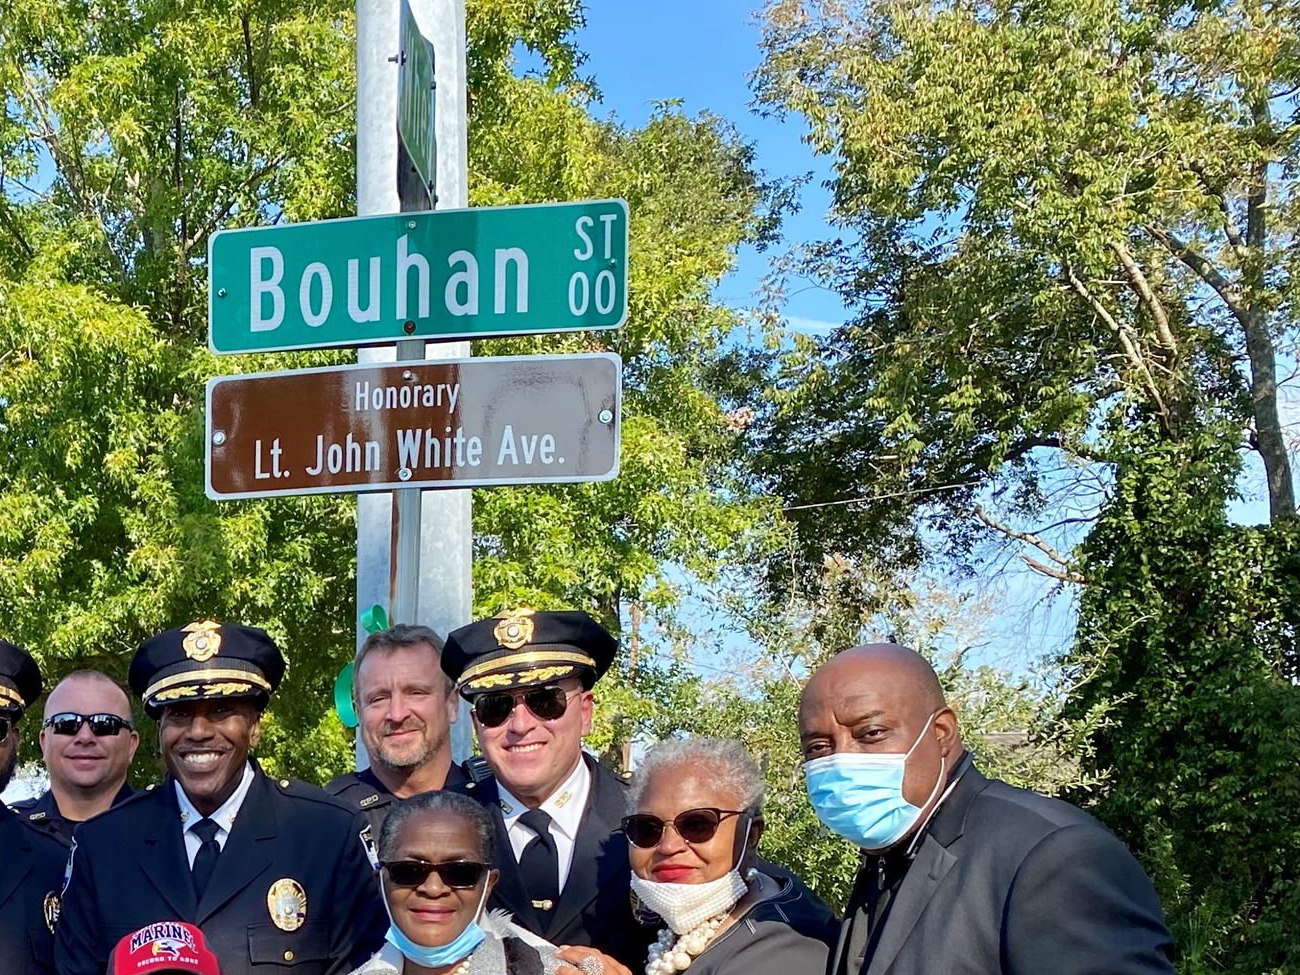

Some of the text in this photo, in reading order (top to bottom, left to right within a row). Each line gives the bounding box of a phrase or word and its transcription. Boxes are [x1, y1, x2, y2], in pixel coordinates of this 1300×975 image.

[574, 213, 618, 262] ST
[250, 234, 529, 332] Bouhan
[568, 270, 616, 317] 00
[355, 381, 460, 414] Honorary
[254, 425, 566, 480] Lt. John White Ave.
